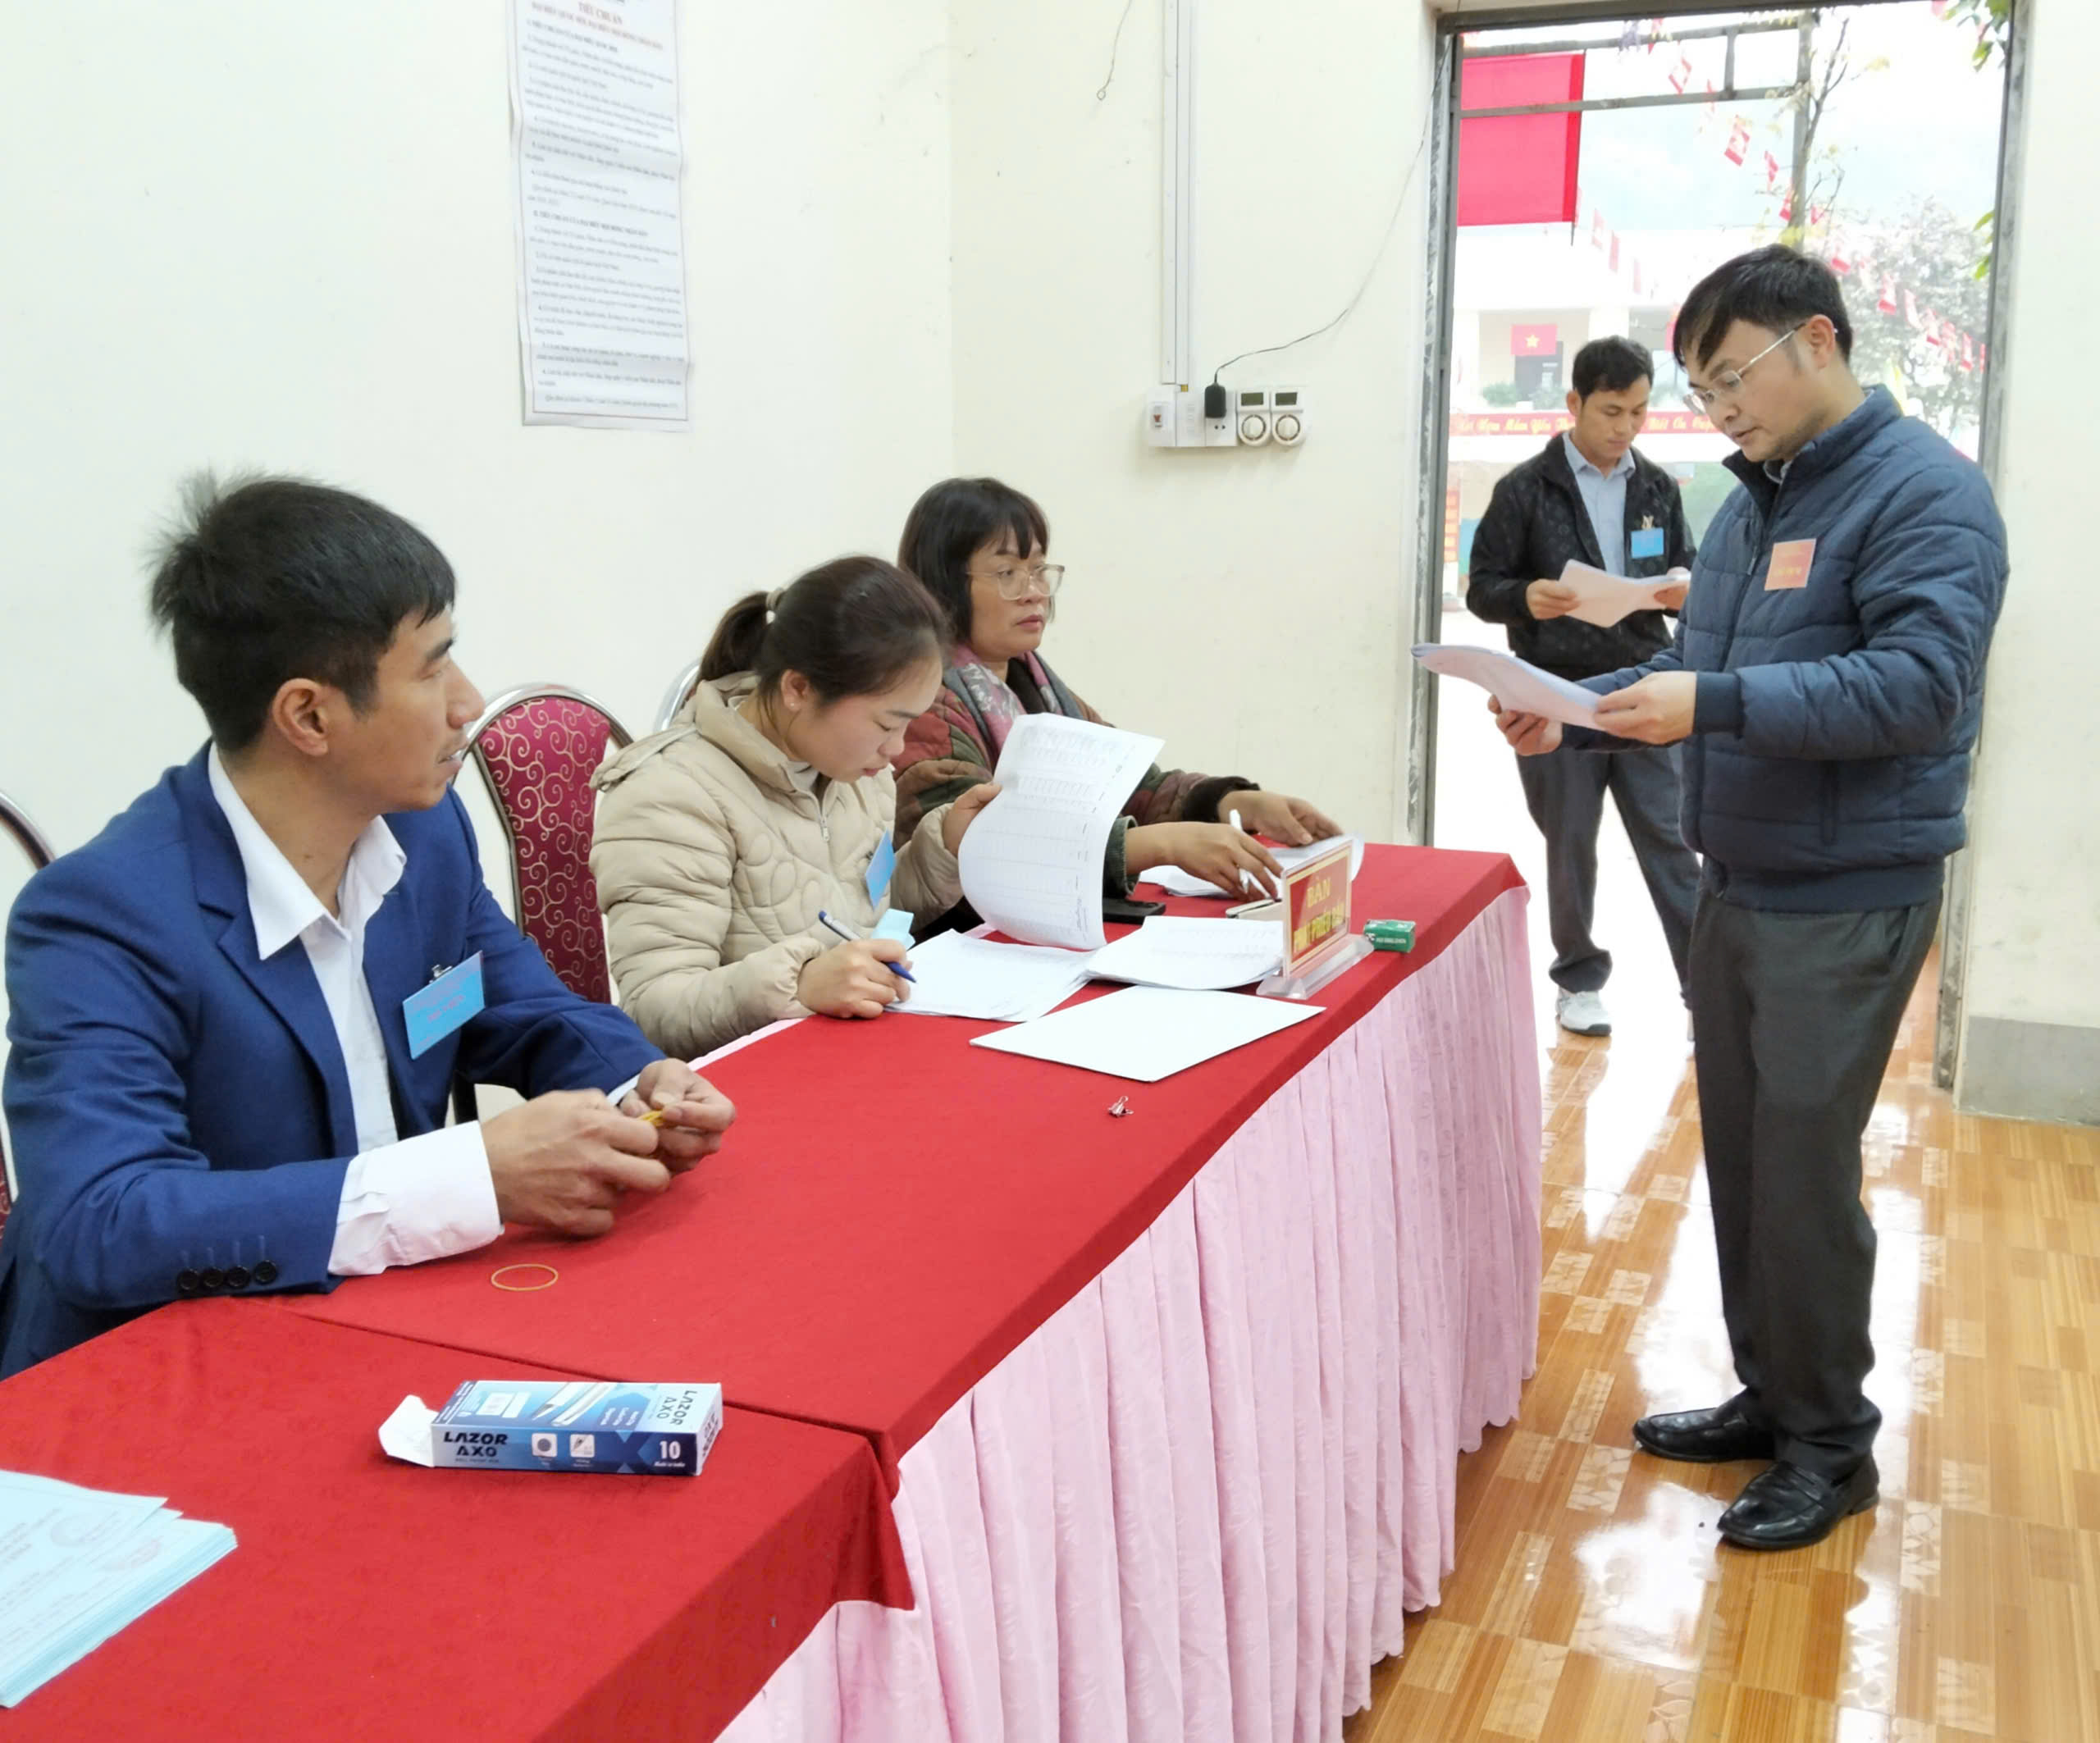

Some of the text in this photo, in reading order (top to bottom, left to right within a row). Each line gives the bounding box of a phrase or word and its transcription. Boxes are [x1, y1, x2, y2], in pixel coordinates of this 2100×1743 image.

[1307, 875, 1331, 908] BÀN
[656, 1397, 678, 1419] AXO
[669, 1390, 698, 1426] LAZOR
[443, 1431, 508, 1445] LAZOR
[456, 1446, 497, 1457] AXO
[660, 1441, 680, 1459] 10
